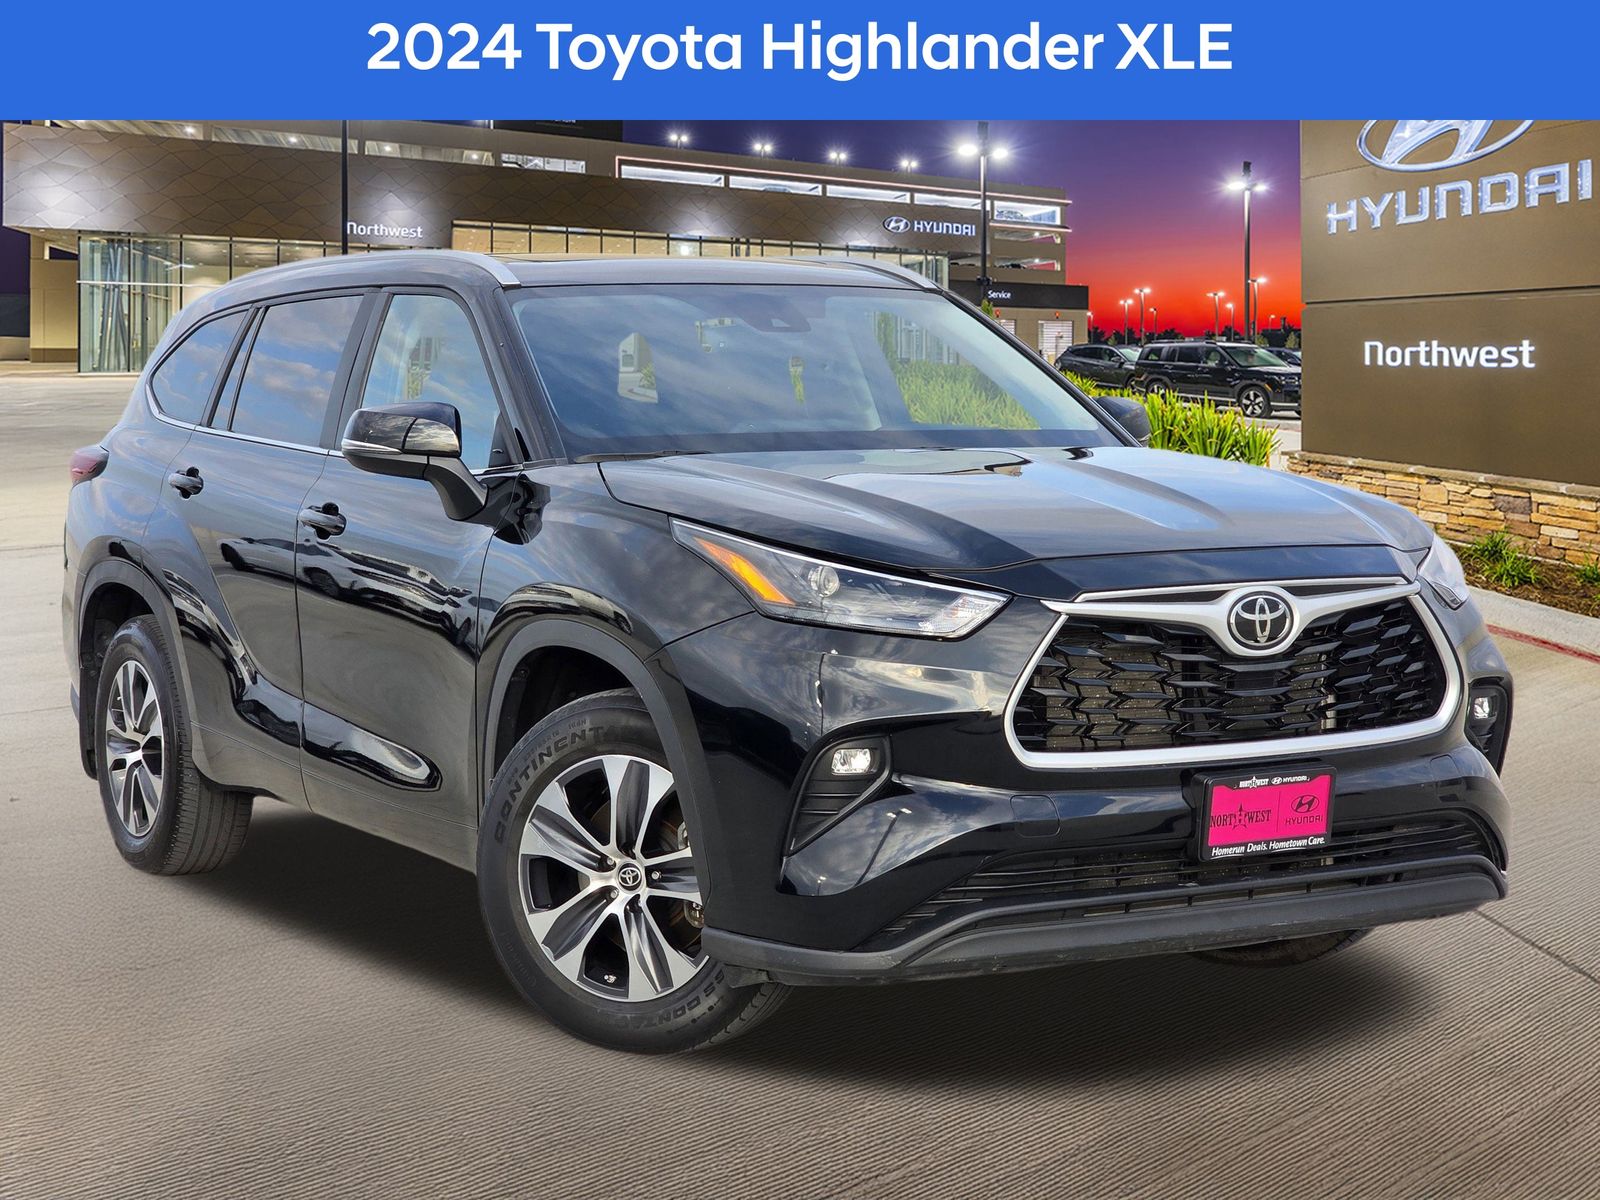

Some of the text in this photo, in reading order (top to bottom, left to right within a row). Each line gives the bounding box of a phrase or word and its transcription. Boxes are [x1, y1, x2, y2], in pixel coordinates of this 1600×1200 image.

[1326, 159, 1592, 234] HYUNDAI
[346, 221, 423, 238] Northwest
[914, 220, 976, 236] HYUNDAI
[987, 289, 1012, 300] Service
[1363, 339, 1536, 368] Northwest
[1285, 814, 1323, 826] HYUNDAI
[1211, 836, 1325, 856] Homerun Deals. Hometown Care.
